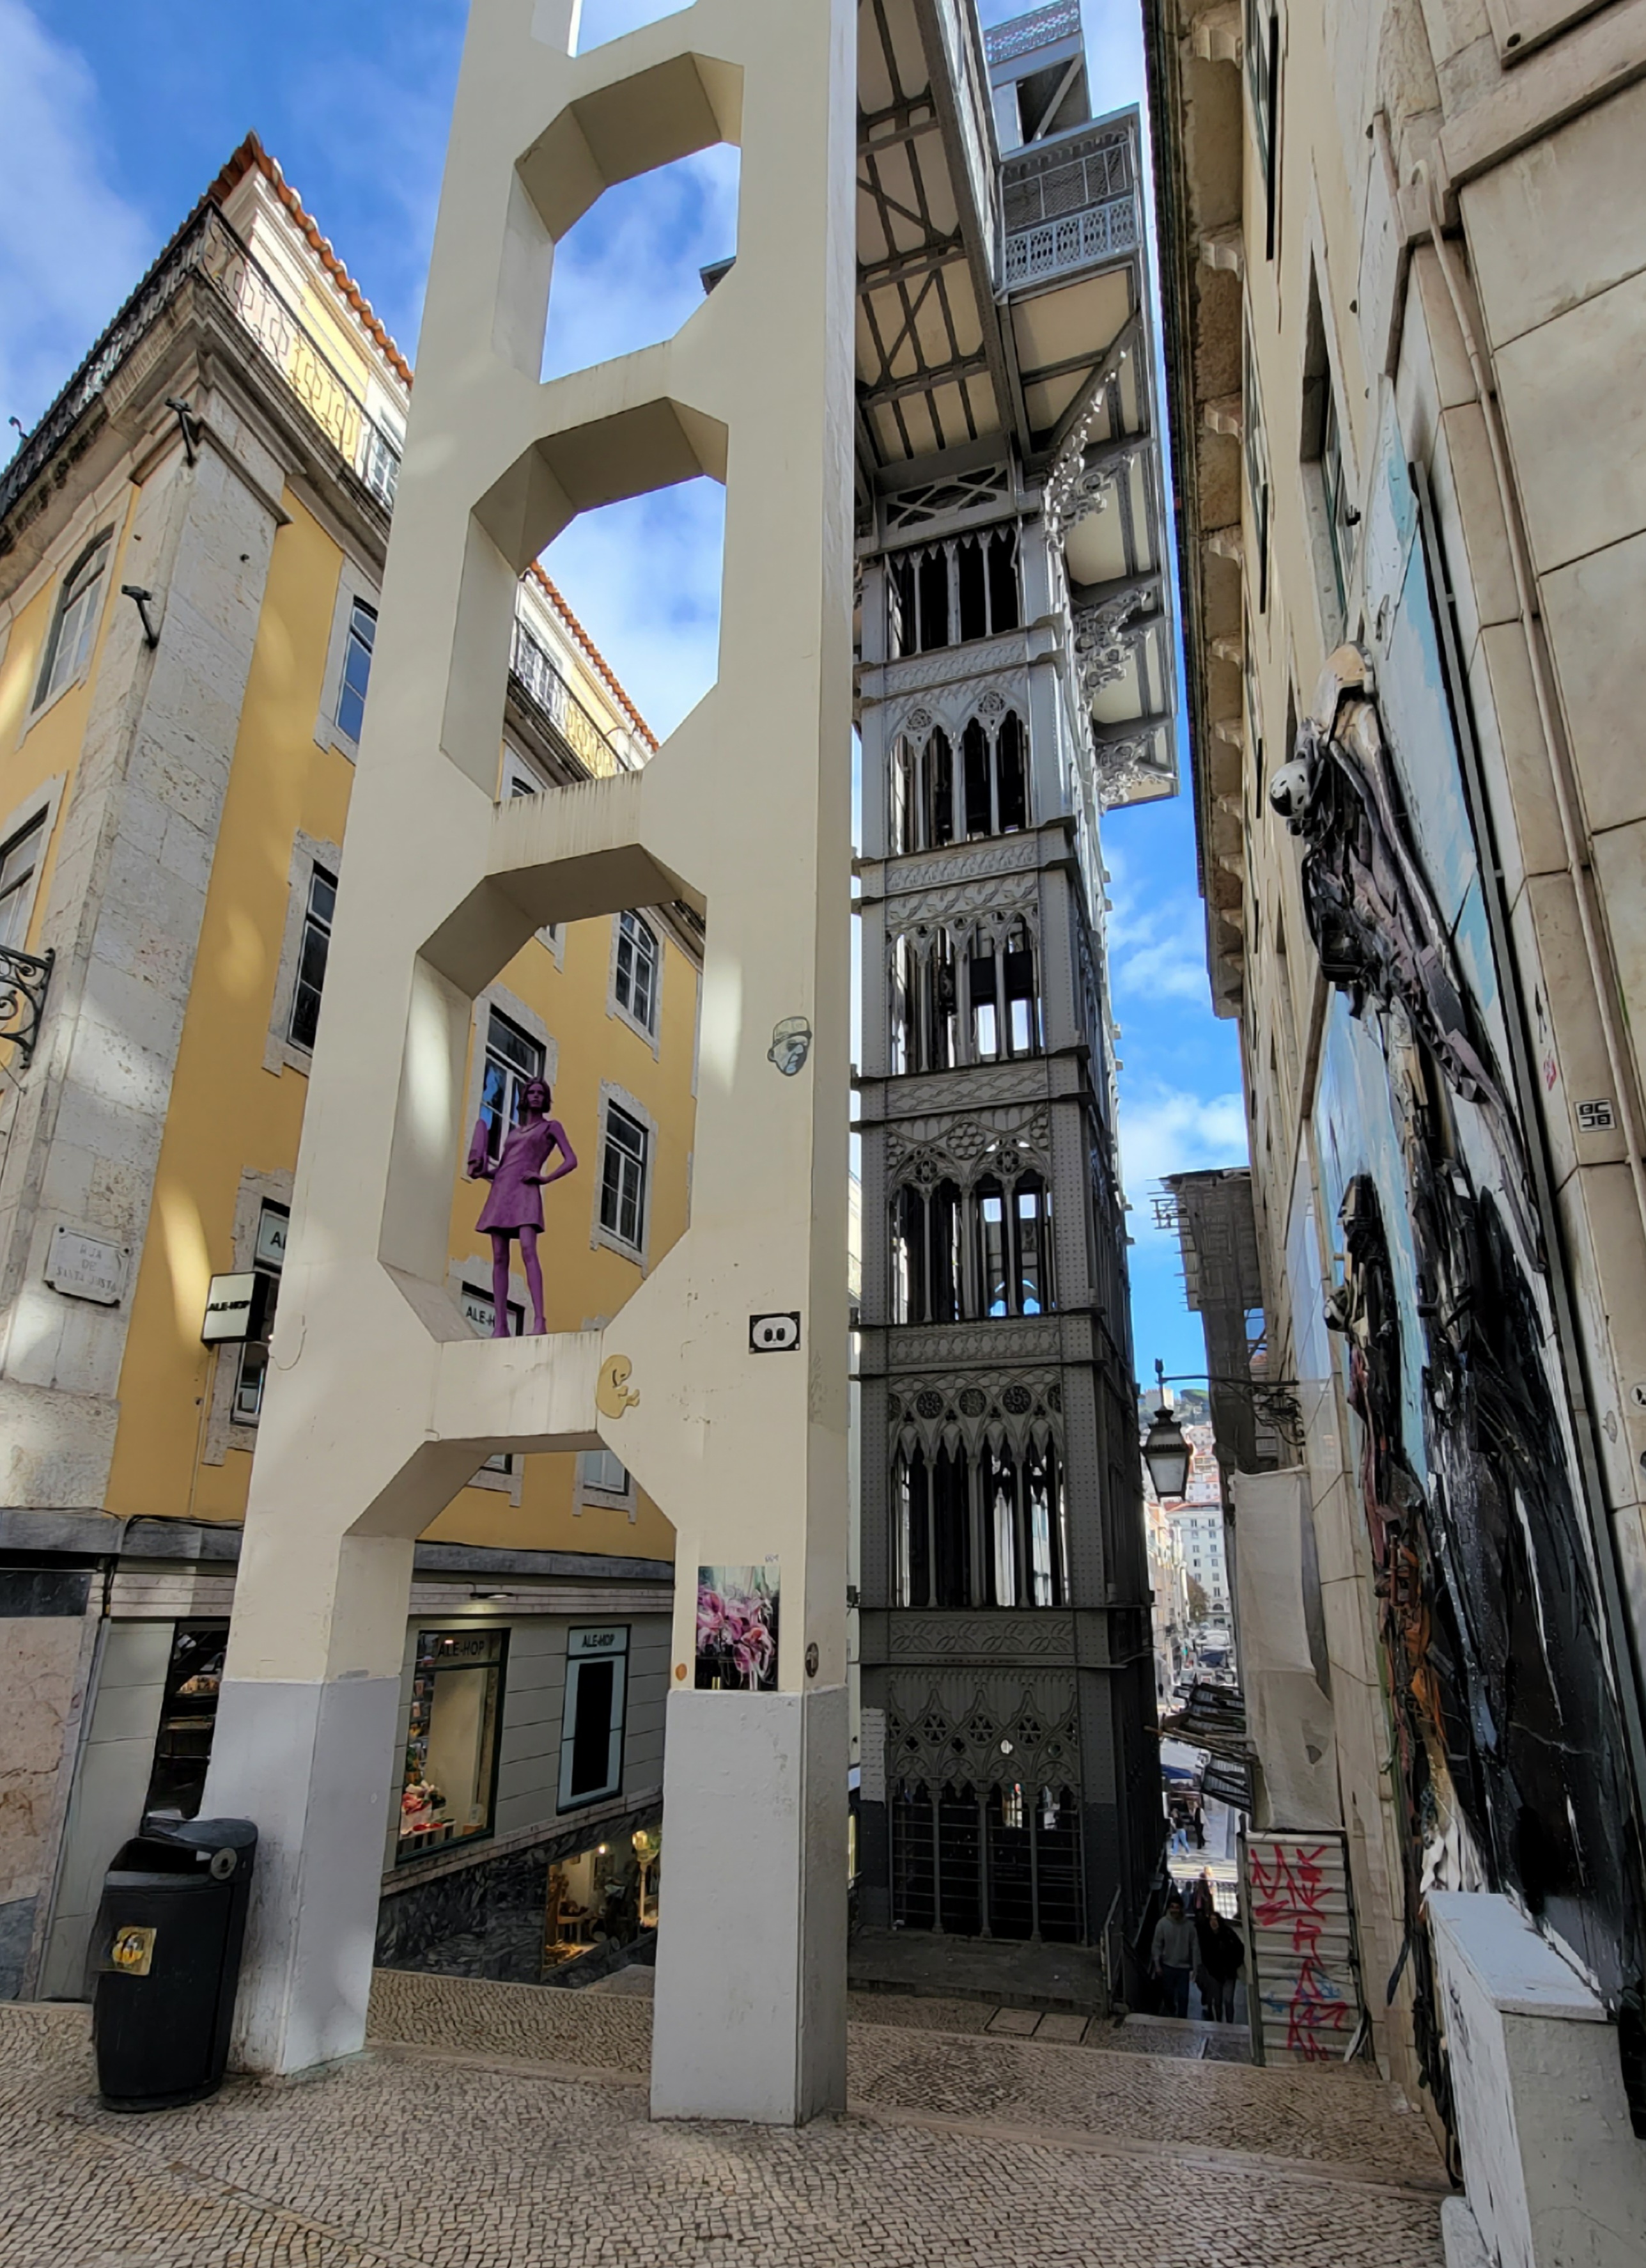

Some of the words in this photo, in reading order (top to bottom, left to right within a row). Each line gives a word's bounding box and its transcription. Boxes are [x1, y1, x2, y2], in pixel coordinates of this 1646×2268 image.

[80, 1244, 102, 1259] RUA
[81, 1259, 97, 1271] DE
[208, 1300, 251, 1311] ALE-HOP
[466, 1306, 495, 1328] ALE-H
[582, 1633, 616, 1648] ALE-HOP
[437, 1640, 485, 1657] ALE-HOP
